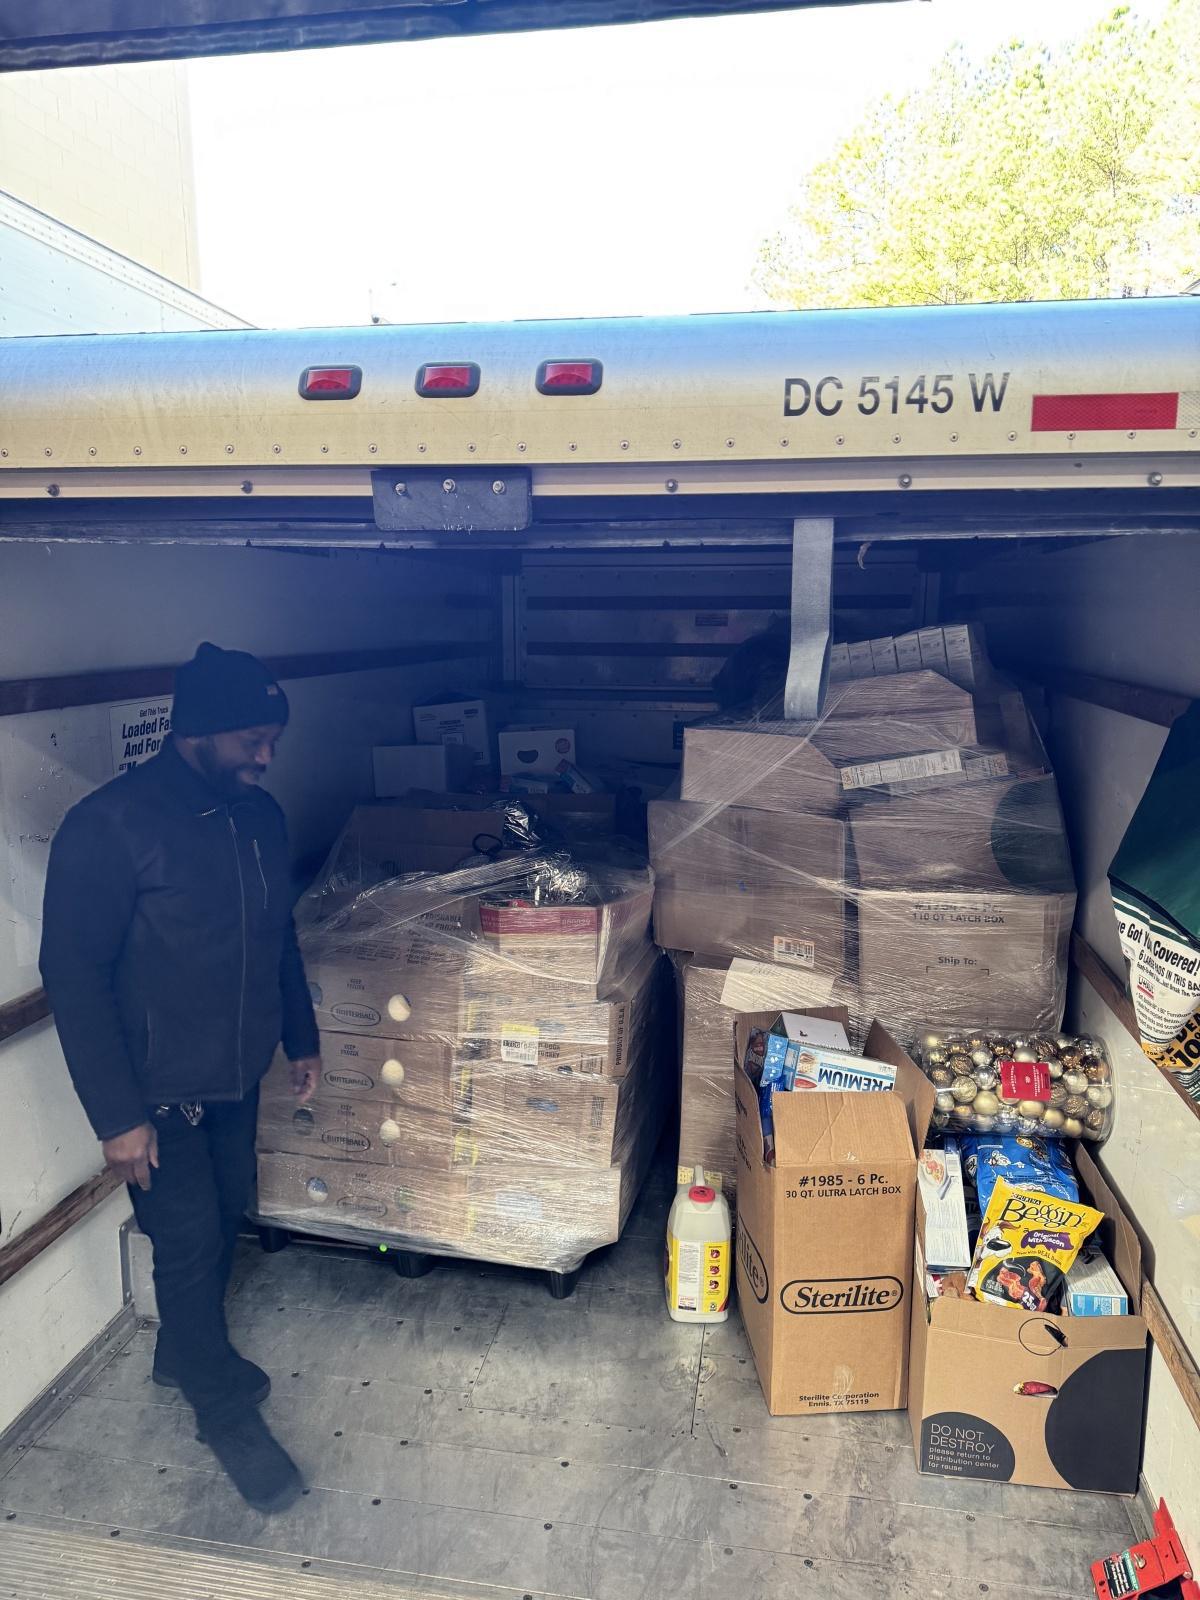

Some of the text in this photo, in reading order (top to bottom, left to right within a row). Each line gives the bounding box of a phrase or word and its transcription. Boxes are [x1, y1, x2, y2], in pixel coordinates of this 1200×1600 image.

[783, 371, 1011, 417] DC 5145 W
[122, 717, 171, 738] Loaded Fa
[123, 739, 144, 758] And
[950, 914, 981, 922] LATCH
[984, 915, 1005, 923] BOX
[1127, 922, 1143, 944] Got
[938, 956, 977, 966] Ship To:
[1138, 949, 1145, 961] 6
[1174, 973, 1187, 988] THIS
[818, 1067, 894, 1092] PREMIUM
[799, 1175, 844, 1187] #1985
[857, 1174, 865, 1185] 6
[870, 1173, 889, 1184] Pc.
[786, 1186, 901, 1199] 30 QT. ULTRA LATCH BOX
[999, 1198, 1086, 1228] Beggin'
[832, 1392, 880, 1400] Corporation
[931, 1423, 985, 1441] DO NOT
[930, 1434, 995, 1454] DESTROY
[928, 1454, 1000, 1469] distribution center
[929, 1447, 955, 1456] please
[957, 1451, 980, 1460] return
